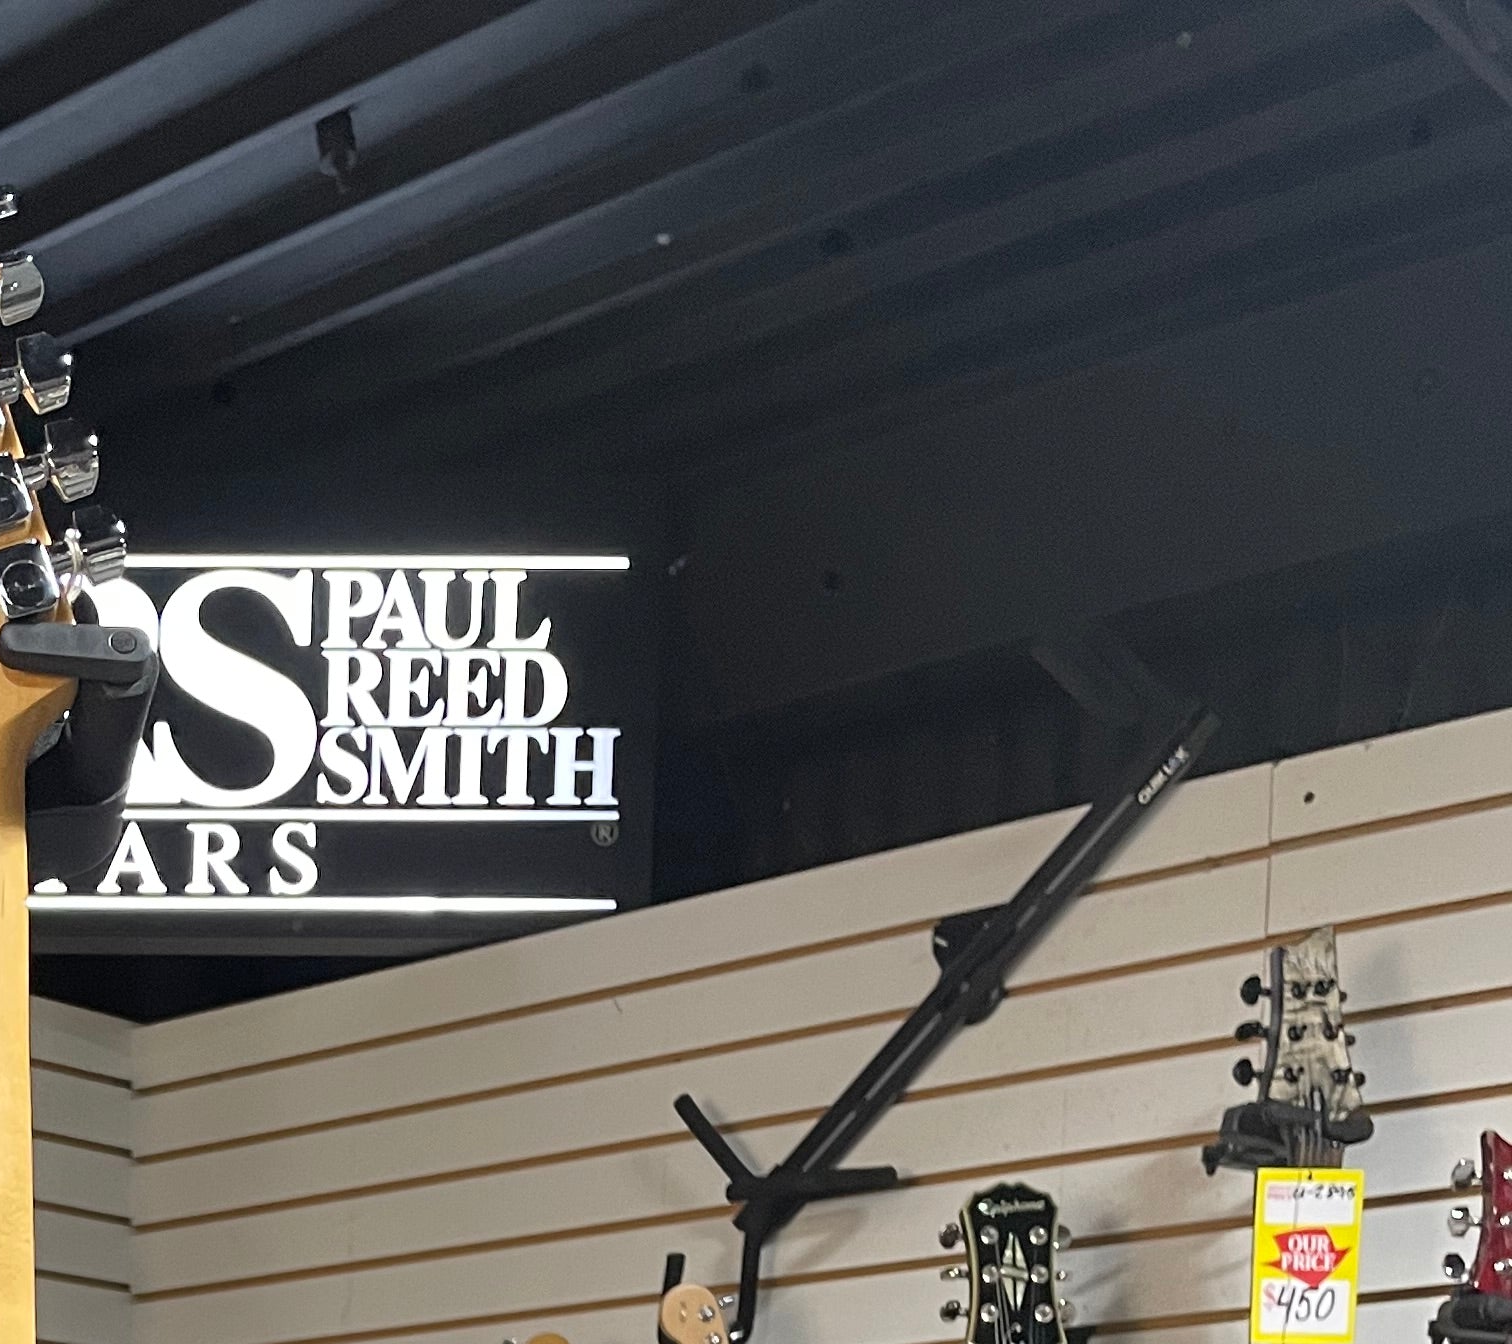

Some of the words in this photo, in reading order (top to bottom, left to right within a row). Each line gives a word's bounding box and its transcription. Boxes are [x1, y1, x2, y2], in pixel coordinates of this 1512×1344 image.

[320, 568, 552, 650] PAUL
[320, 647, 569, 728] REED
[316, 726, 622, 807] SMITH
[1281, 1251, 1337, 1272] PRICE
[1288, 1234, 1330, 1254] OUR
